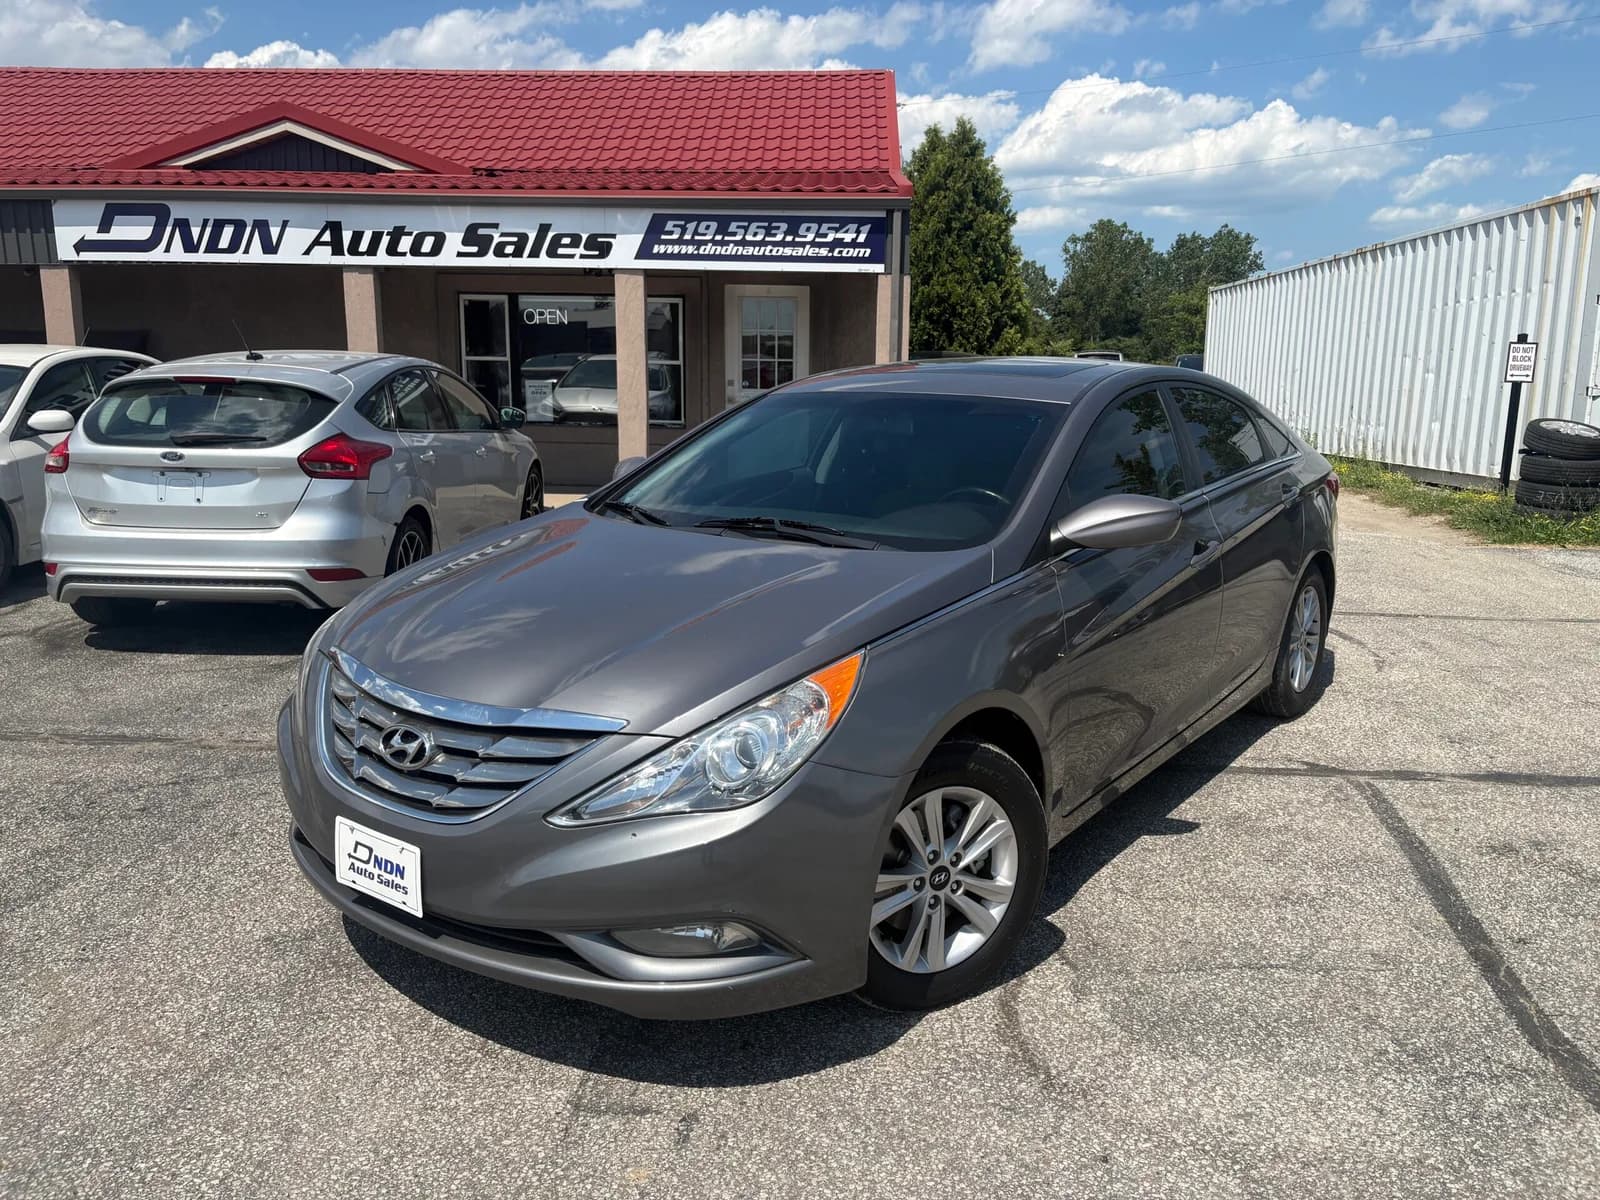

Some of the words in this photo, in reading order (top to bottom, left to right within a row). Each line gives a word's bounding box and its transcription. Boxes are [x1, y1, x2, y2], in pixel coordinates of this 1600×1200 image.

[72, 203, 290, 256] DNDN
[302, 220, 446, 257] Auto
[456, 223, 617, 259] Sales
[660, 220, 872, 243] 519.563.9541
[652, 243, 872, 257] www.dndnautosales.com
[523, 308, 568, 325] OPEN
[1511, 346, 1521, 354] DO
[1521, 346, 1534, 354] NOT
[1509, 363, 1532, 371] DRIVEWAY
[347, 840, 406, 880] DNDN
[348, 861, 375, 881] Auto
[376, 874, 408, 895] Sales
